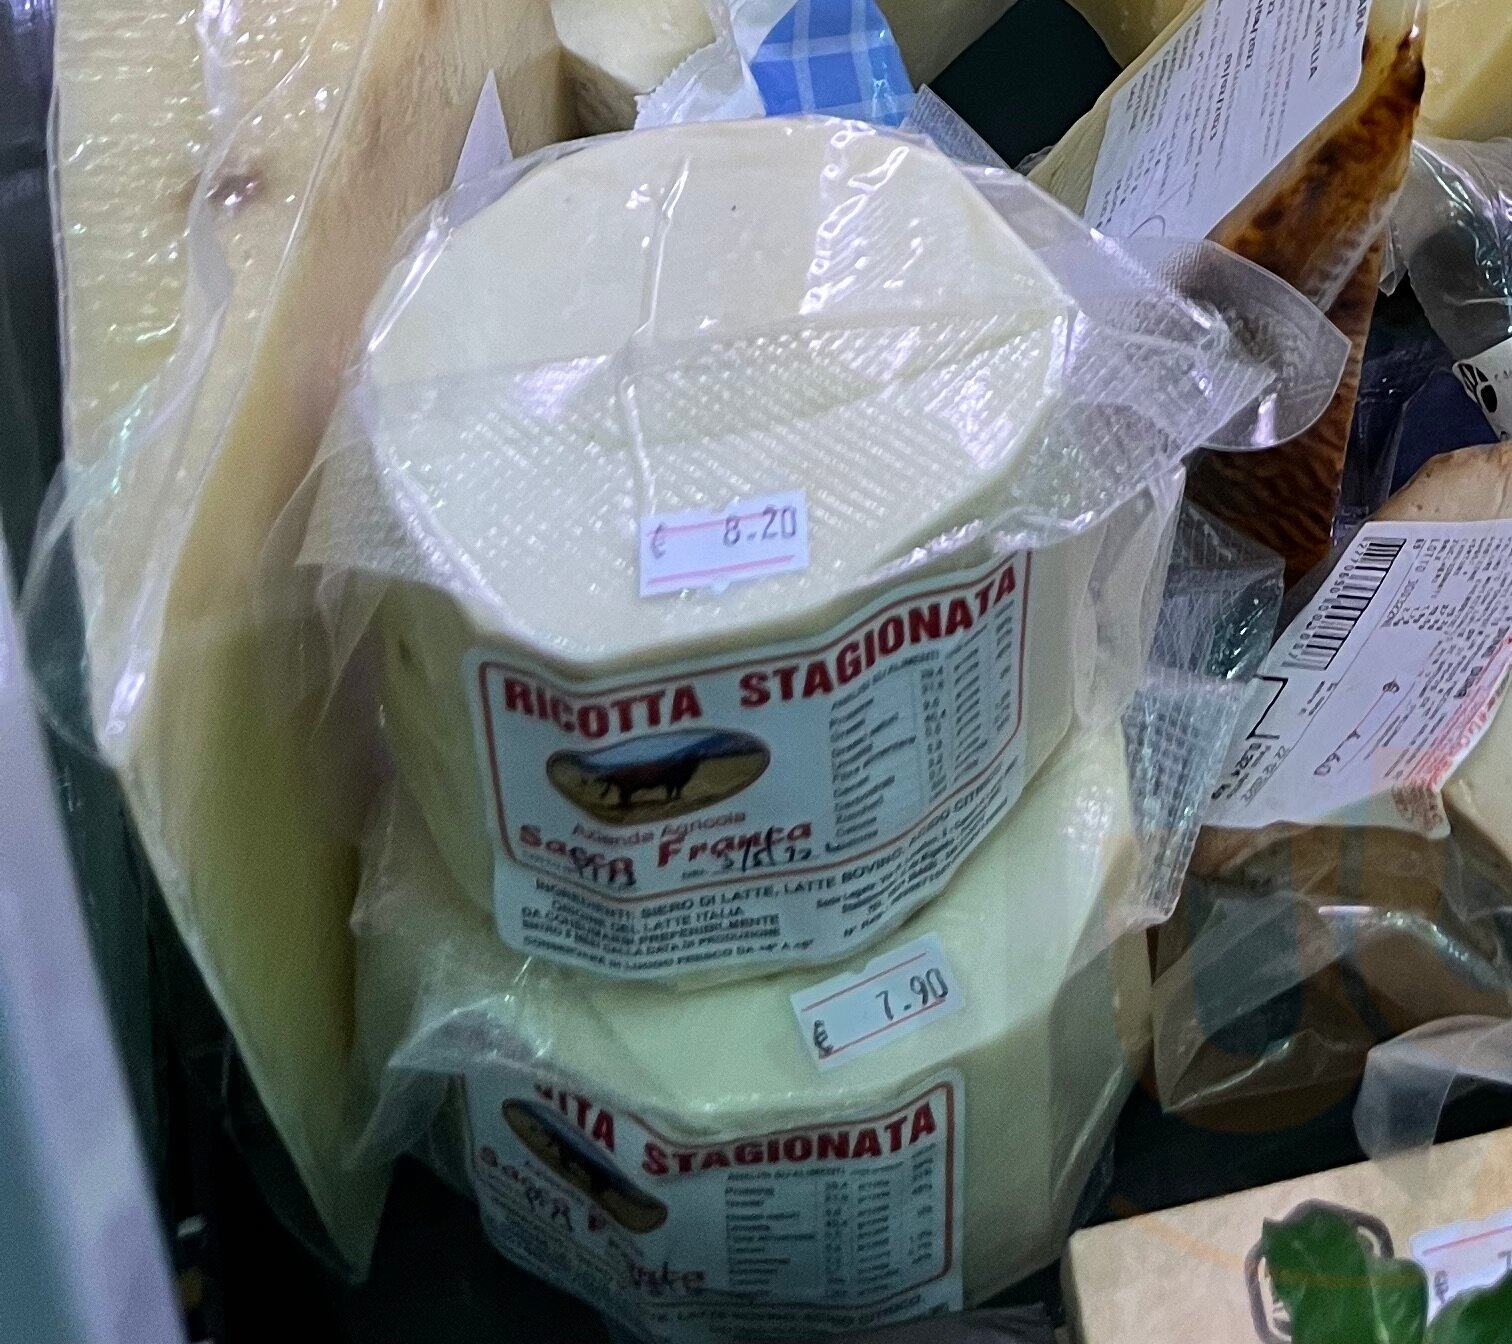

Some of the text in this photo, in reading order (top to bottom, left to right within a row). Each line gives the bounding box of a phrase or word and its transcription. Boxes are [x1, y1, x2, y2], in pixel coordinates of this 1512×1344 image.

[721, 504, 799, 548] 8.20
[504, 563, 1017, 741] RICOTTA STAGIONATA
[873, 967, 951, 1023] 7.90
[640, 1101, 939, 1178] STAGIONATA
